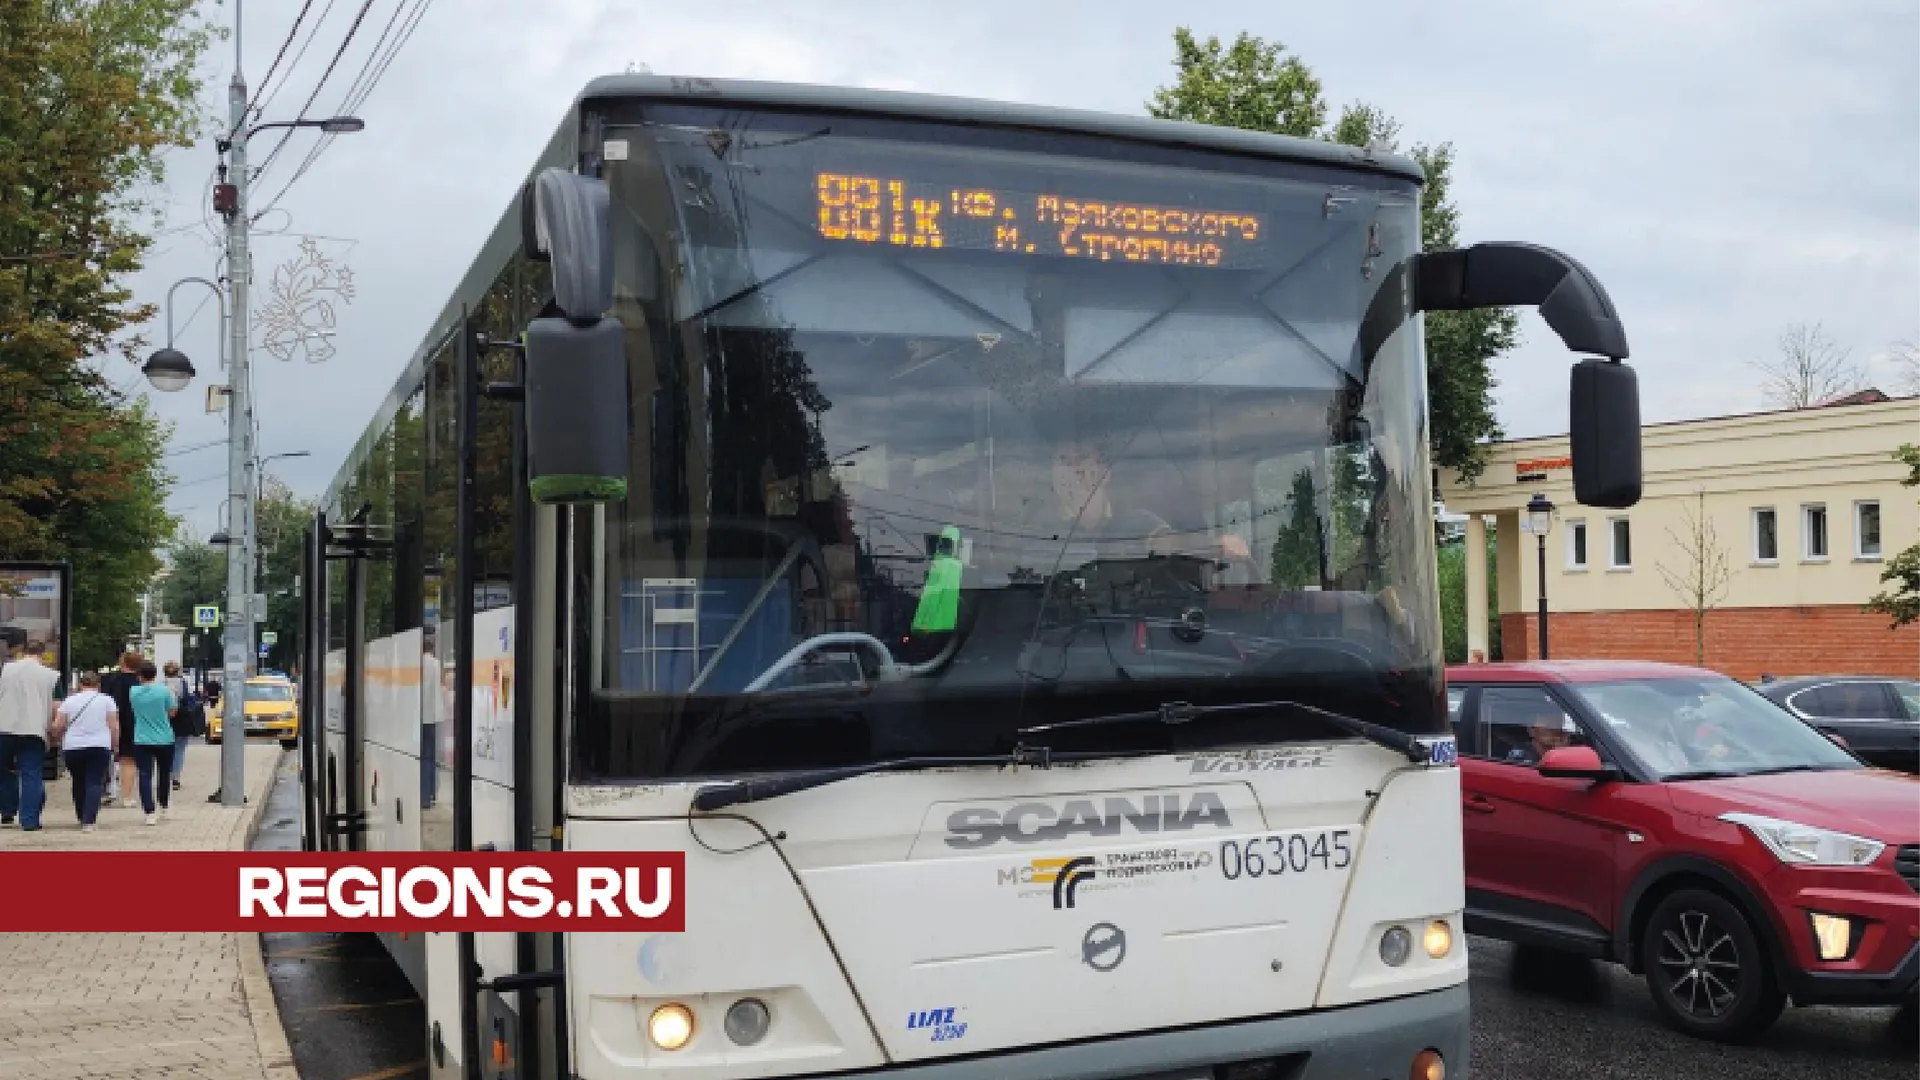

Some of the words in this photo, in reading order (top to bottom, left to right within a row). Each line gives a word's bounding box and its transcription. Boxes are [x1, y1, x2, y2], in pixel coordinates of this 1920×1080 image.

[1037, 194, 1258, 240] Маяковского
[1059, 221, 1221, 265] Строгино
[944, 791, 1234, 850] SCANIA
[1219, 830, 1352, 881] 063045
